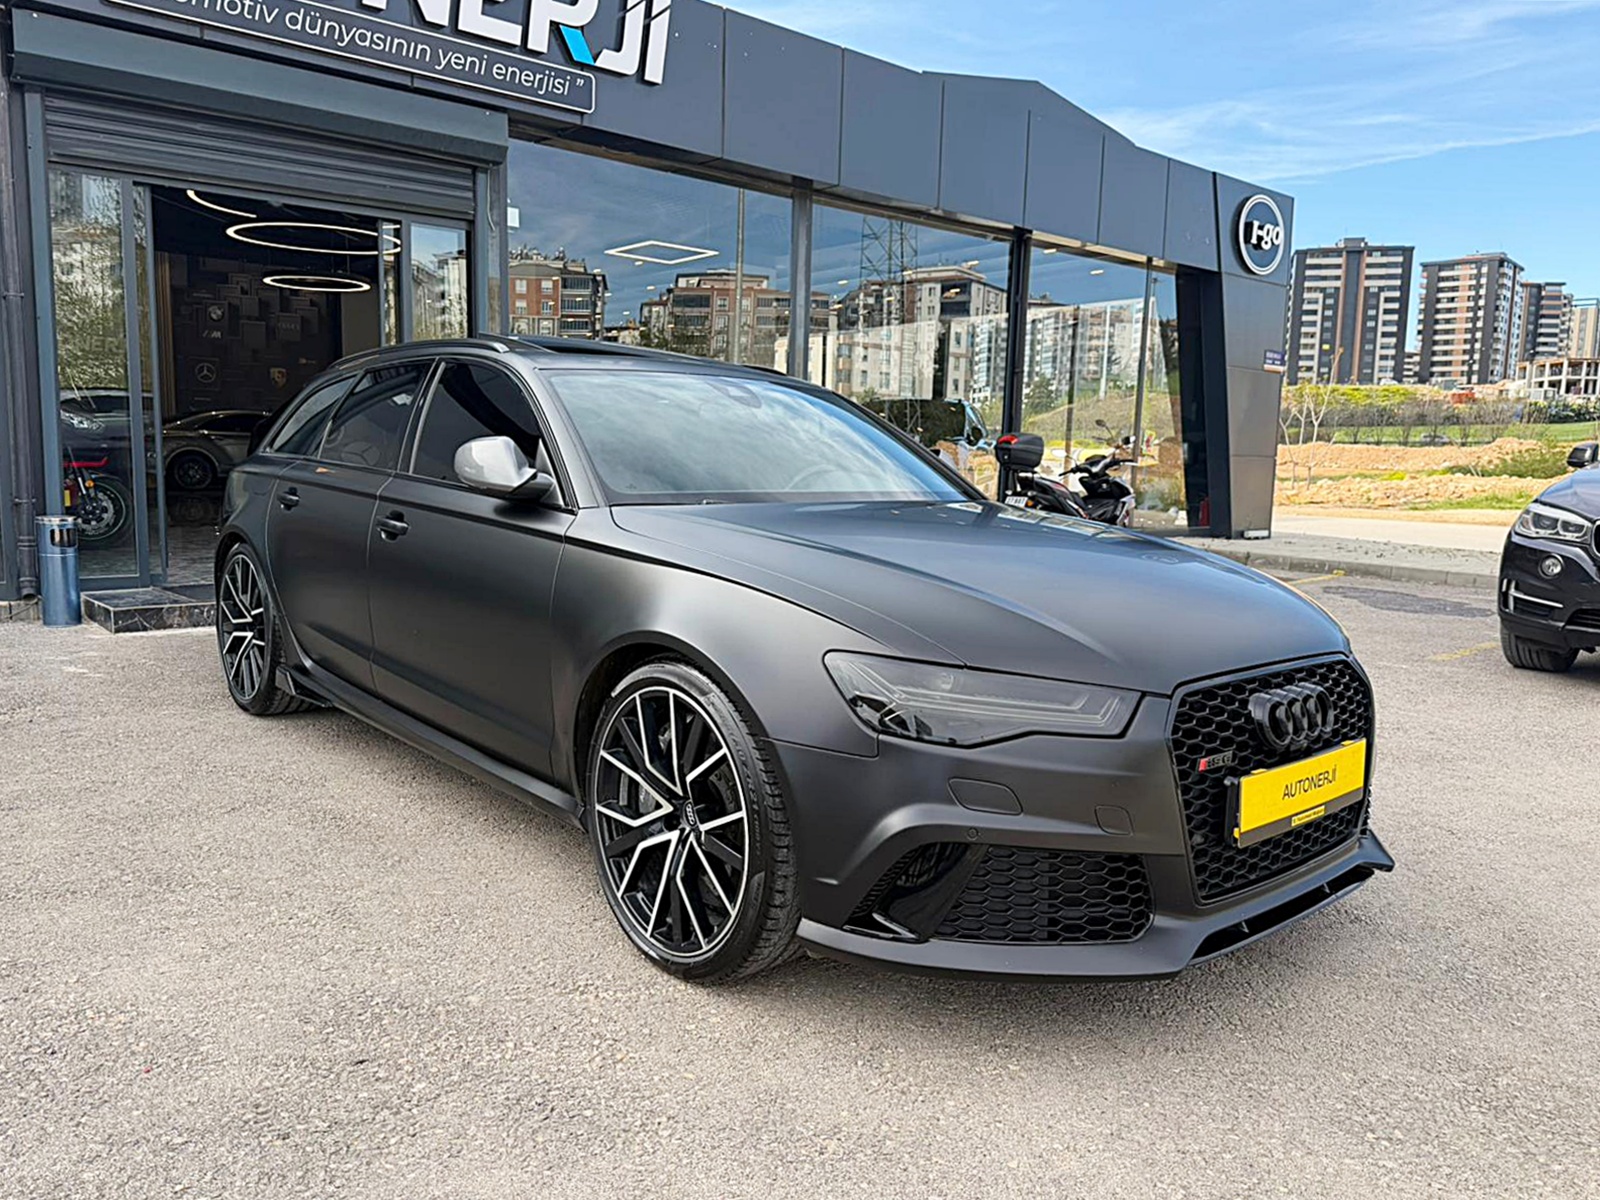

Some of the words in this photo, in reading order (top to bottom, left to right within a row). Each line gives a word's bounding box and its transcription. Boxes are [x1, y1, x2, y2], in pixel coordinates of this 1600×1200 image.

[284, 8, 431, 62] dünyasının
[434, 48, 487, 75] yeni
[492, 62, 570, 95] enerjisi
